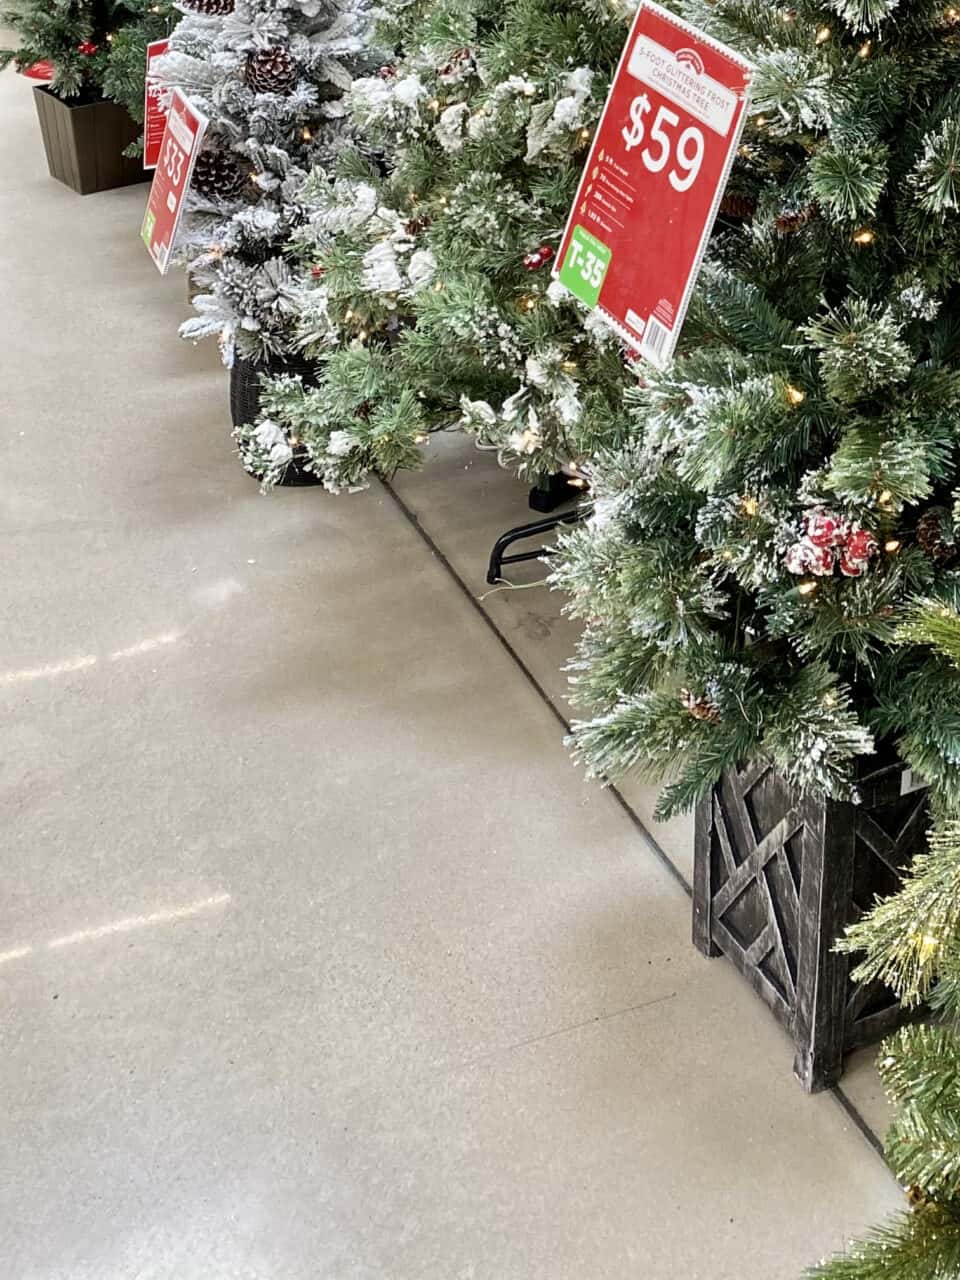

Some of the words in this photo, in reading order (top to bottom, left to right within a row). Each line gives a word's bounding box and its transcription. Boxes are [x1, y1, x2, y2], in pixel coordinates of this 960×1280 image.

[640, 47, 665, 67] 5-FOOT
[665, 63, 707, 94] GLITTERING
[706, 89, 730, 111] FROST
[652, 67, 691, 99] CHRISTMAS
[692, 92, 710, 111] TREE
[164, 137, 185, 187] $33
[621, 92, 705, 193] $59
[569, 239, 606, 289] T-35
